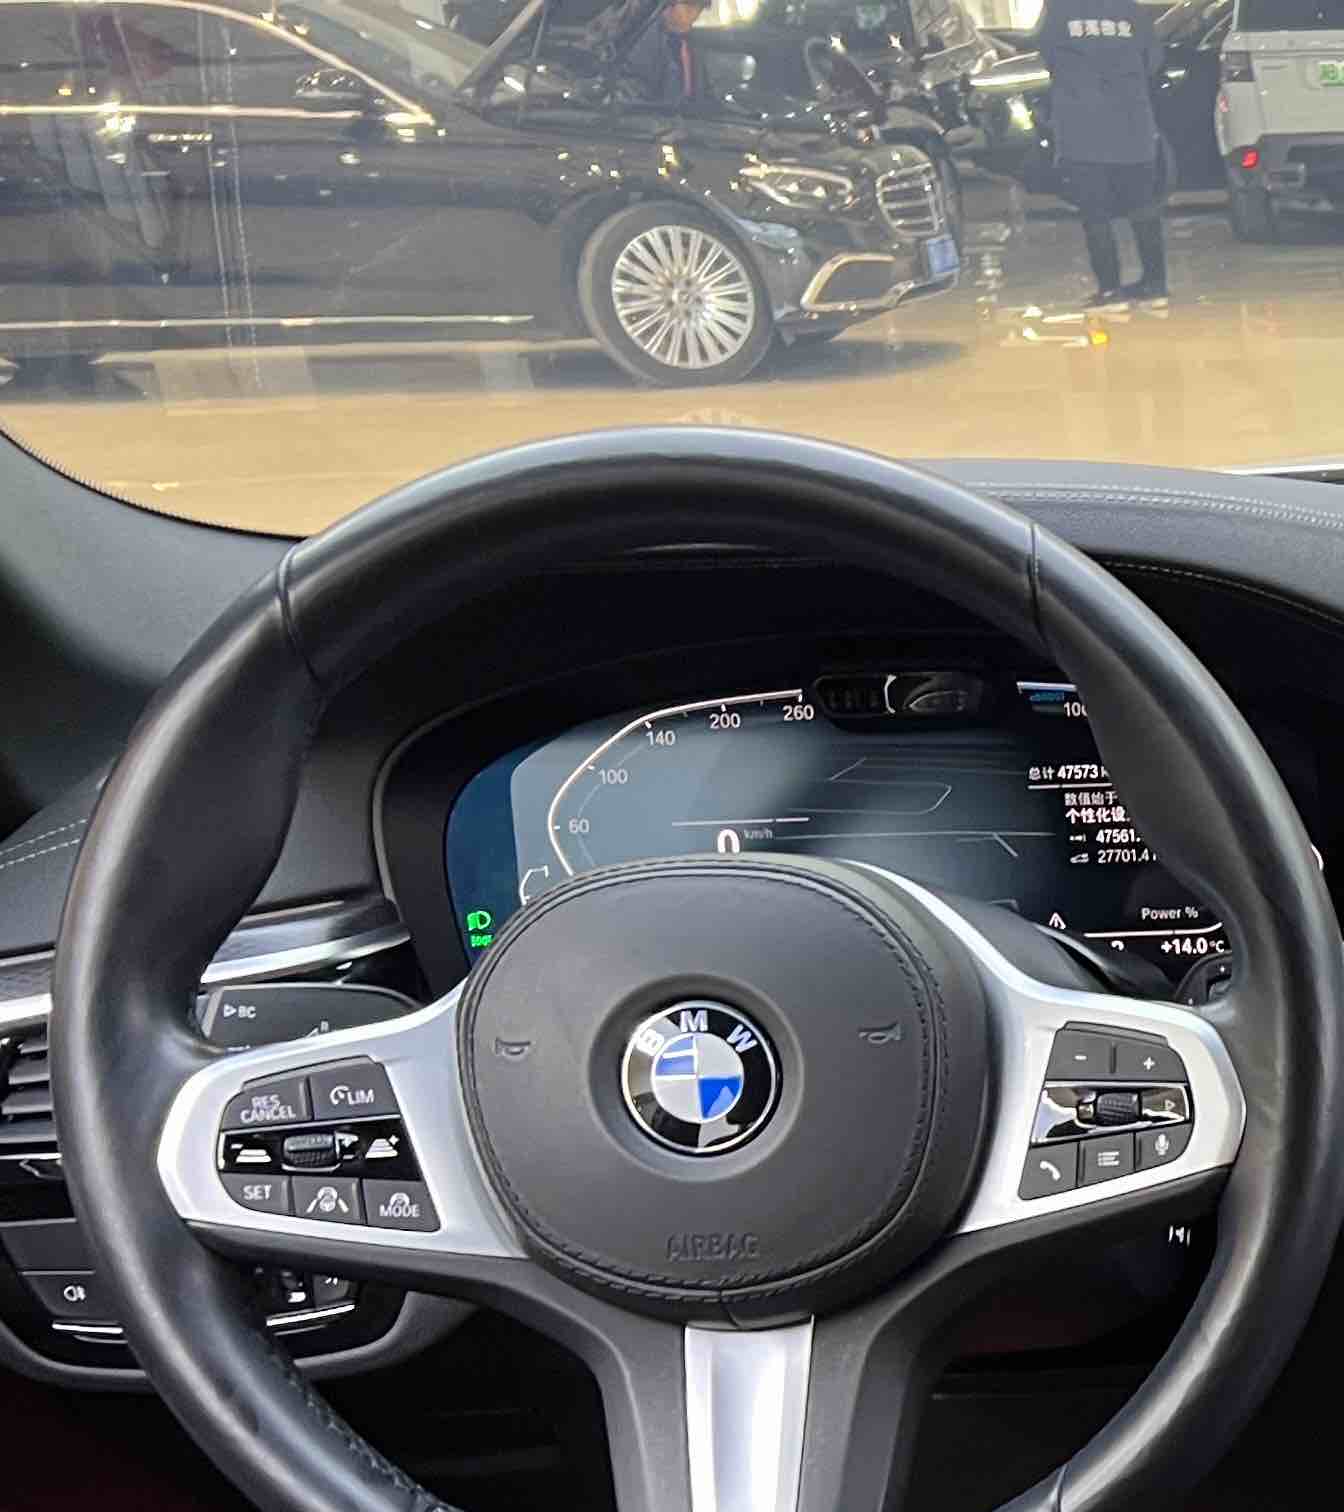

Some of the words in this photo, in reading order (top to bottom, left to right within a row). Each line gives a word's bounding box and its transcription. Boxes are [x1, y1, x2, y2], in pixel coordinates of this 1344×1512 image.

[709, 713, 741, 729] 200
[783, 705, 814, 721] 260
[646, 731, 676, 746] 140
[600, 769, 628, 785] 100
[1028, 766, 1054, 780] 总计
[1057, 764, 1099, 779] 47573
[568, 819, 589, 833] 60
[743, 829, 774, 840] km/h
[1141, 907, 1181, 920] Power
[1184, 907, 1199, 918] %
[1160, 938, 1208, 954] +14.0
[635, 1010, 758, 1057] BMW
[251, 1094, 281, 1109] RES
[346, 1089, 375, 1105] LIM
[240, 1105, 296, 1123] CANCEL
[243, 1184, 273, 1201] SET
[378, 1204, 421, 1219] MODE
[666, 1232, 759, 1262] AIRBAG
